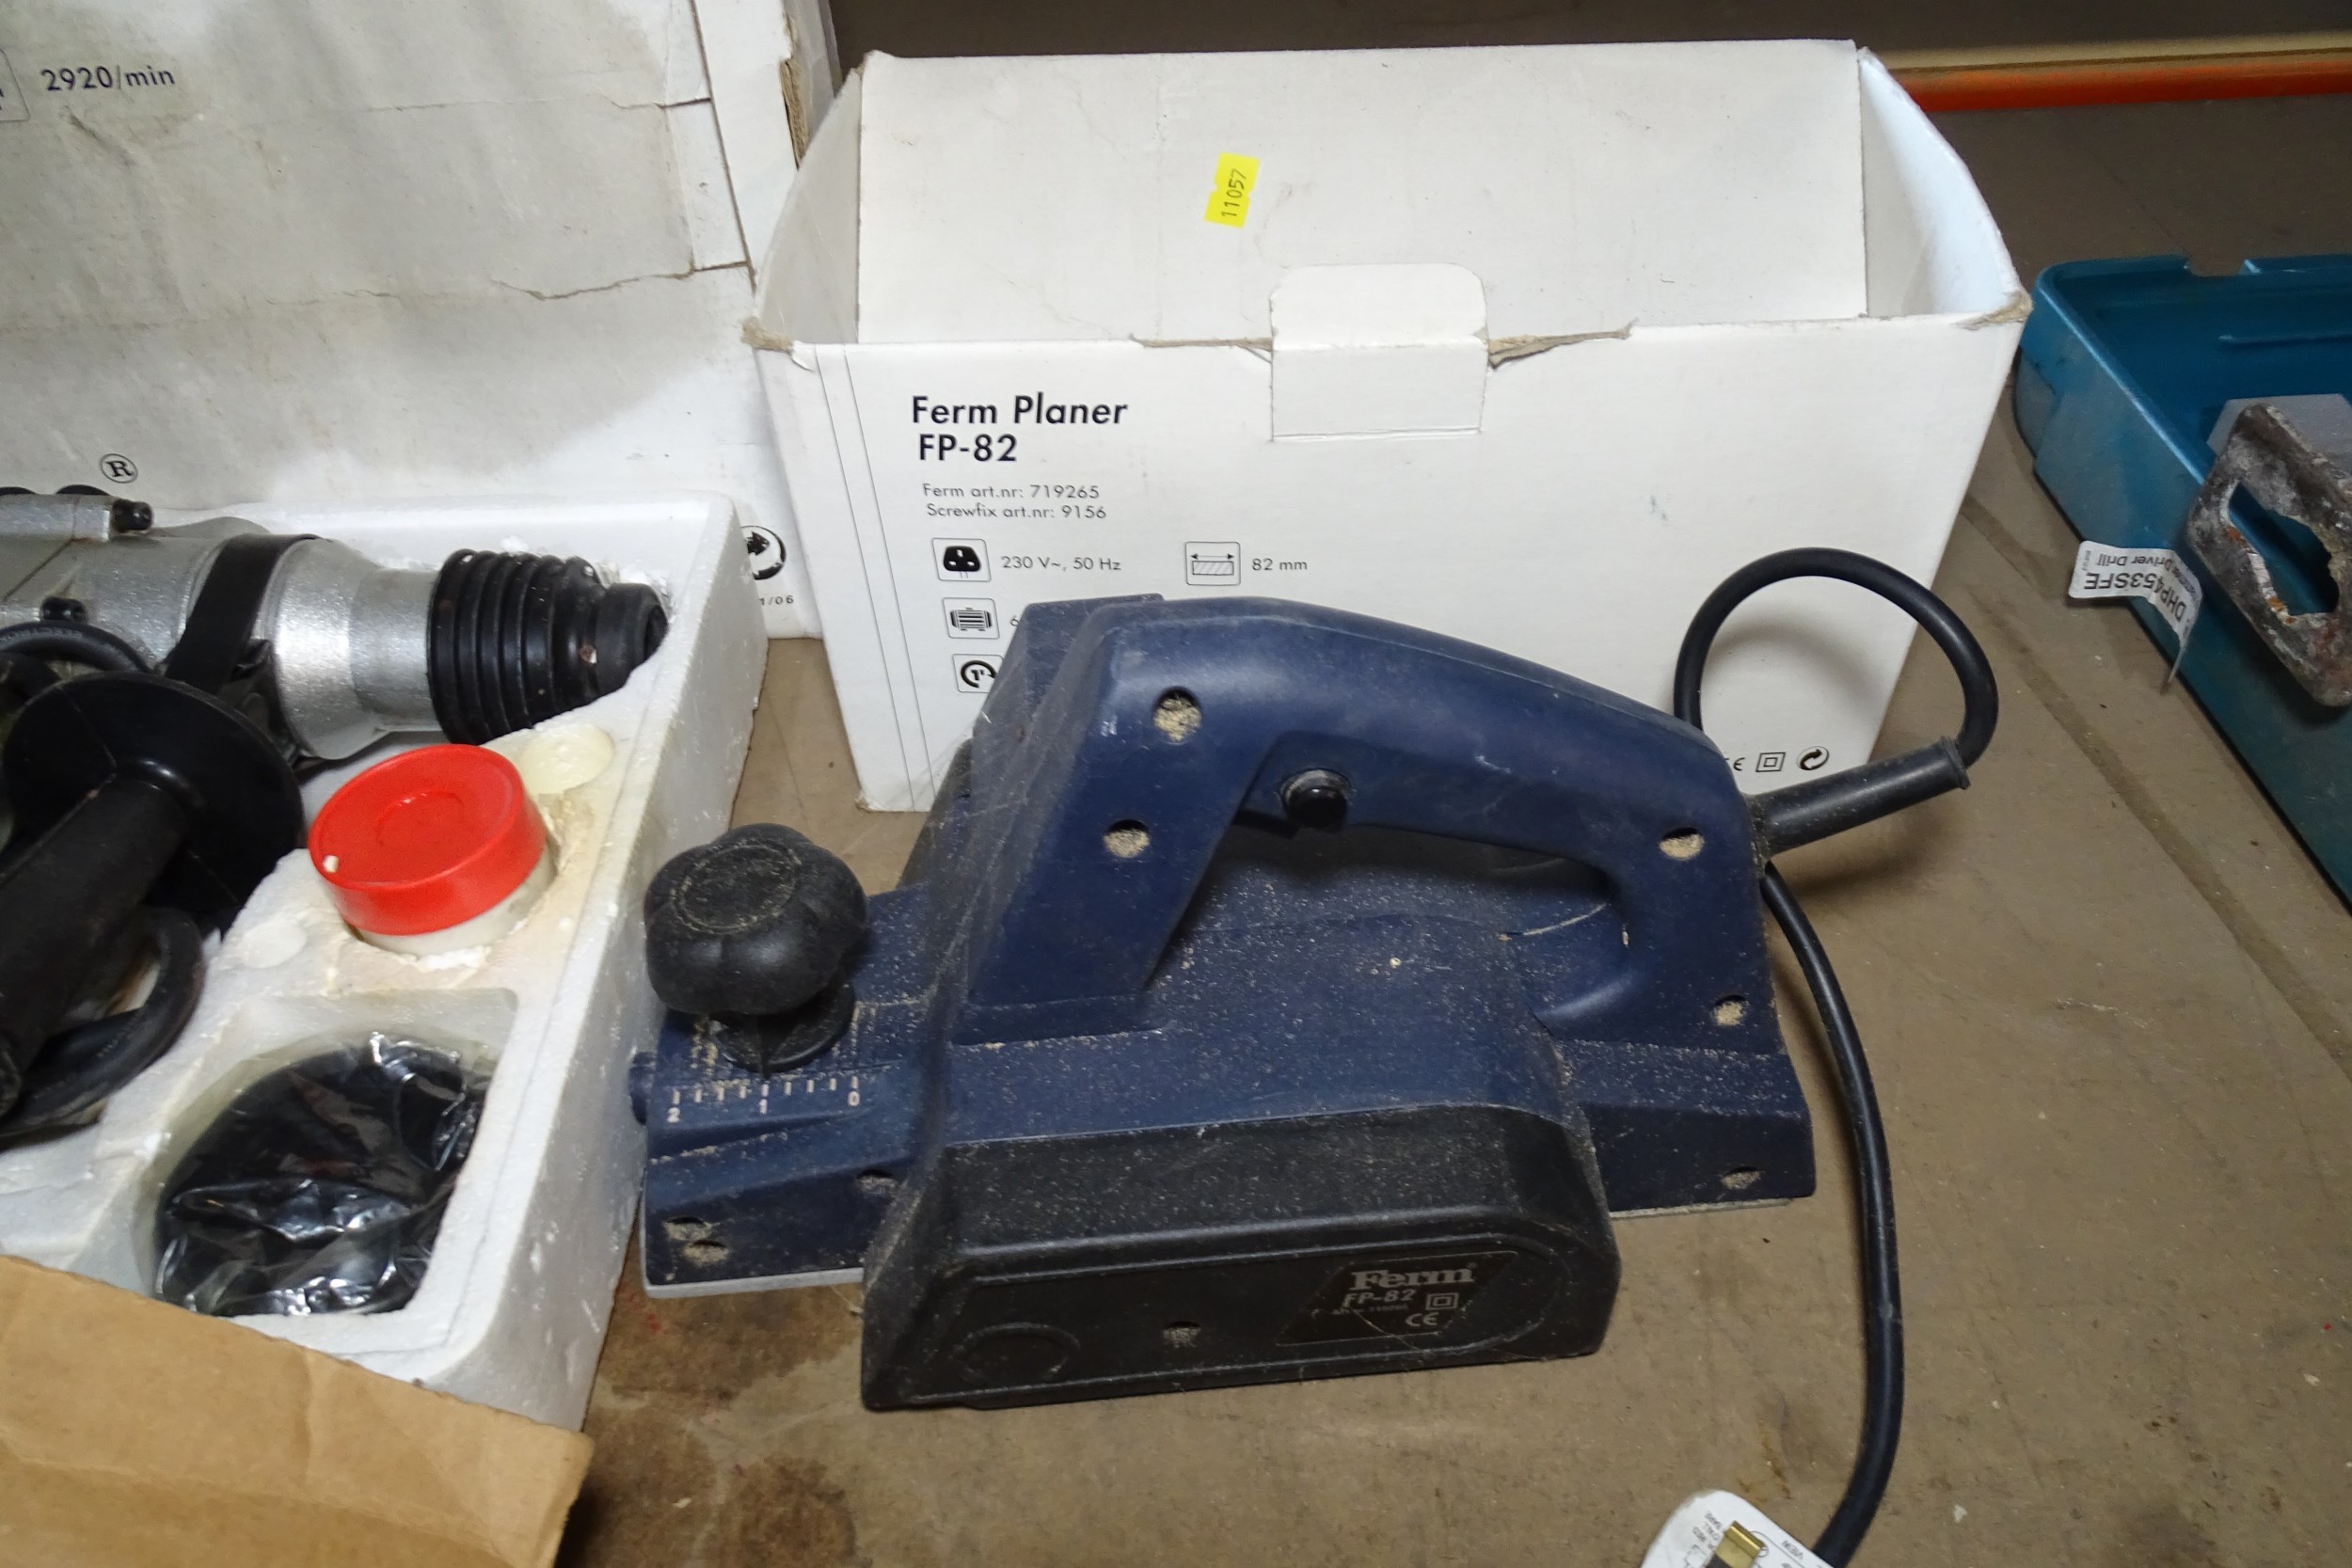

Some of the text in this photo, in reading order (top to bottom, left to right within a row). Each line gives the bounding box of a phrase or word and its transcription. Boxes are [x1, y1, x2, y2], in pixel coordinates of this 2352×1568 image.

[40, 64, 176, 91] 2920/min
[1221, 167, 1248, 217] 11057
[912, 391, 1128, 424] Ferm Planer
[919, 433, 1018, 462] FP-82
[923, 483, 1100, 499] Ferm art.nr: 719265
[927, 502, 1107, 519] Screwfix art.nr: 9156
[1000, 556, 1033, 570] 230
[1073, 557, 1094, 571] 50
[1100, 557, 1122, 571] Hz
[1251, 558, 1309, 571] 82 mm
[2096, 552, 2129, 567] Drill
[2130, 554, 2174, 573] Driver
[1349, 1268, 1475, 1291] Ferm
[1342, 1288, 1418, 1308] FP-82
